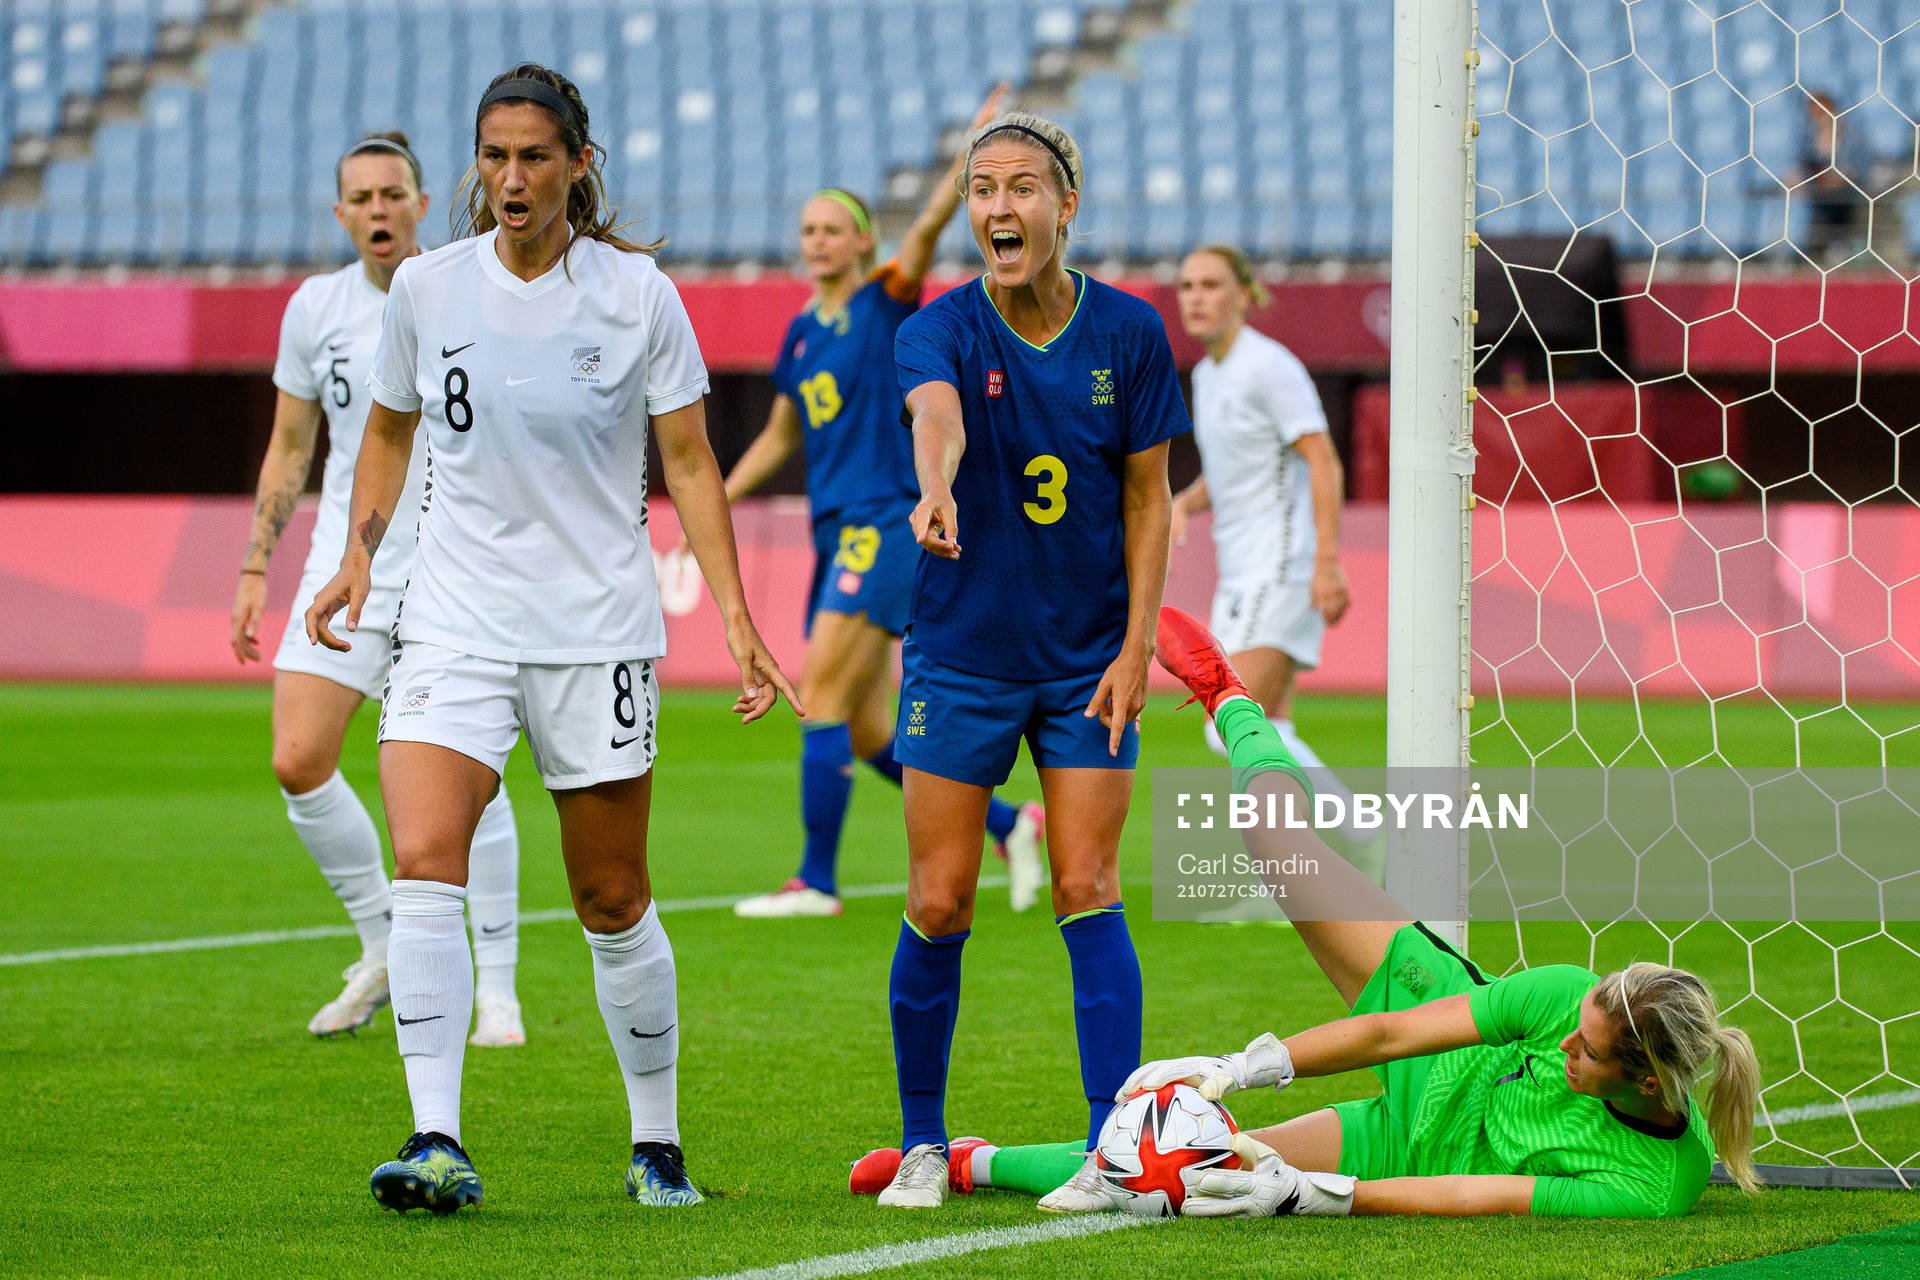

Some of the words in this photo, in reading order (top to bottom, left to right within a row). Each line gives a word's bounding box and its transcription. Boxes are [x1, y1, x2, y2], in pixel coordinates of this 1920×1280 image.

[332, 358, 351, 408] 5
[444, 366, 474, 433] 8
[799, 371, 844, 430] 13
[988, 384, 1002, 396] QLO
[989, 373, 1003, 384] UNI
[1091, 394, 1116, 406] SWE
[1023, 454, 1068, 525] 3
[612, 662, 636, 729] 8
[906, 725, 926, 736] SWE
